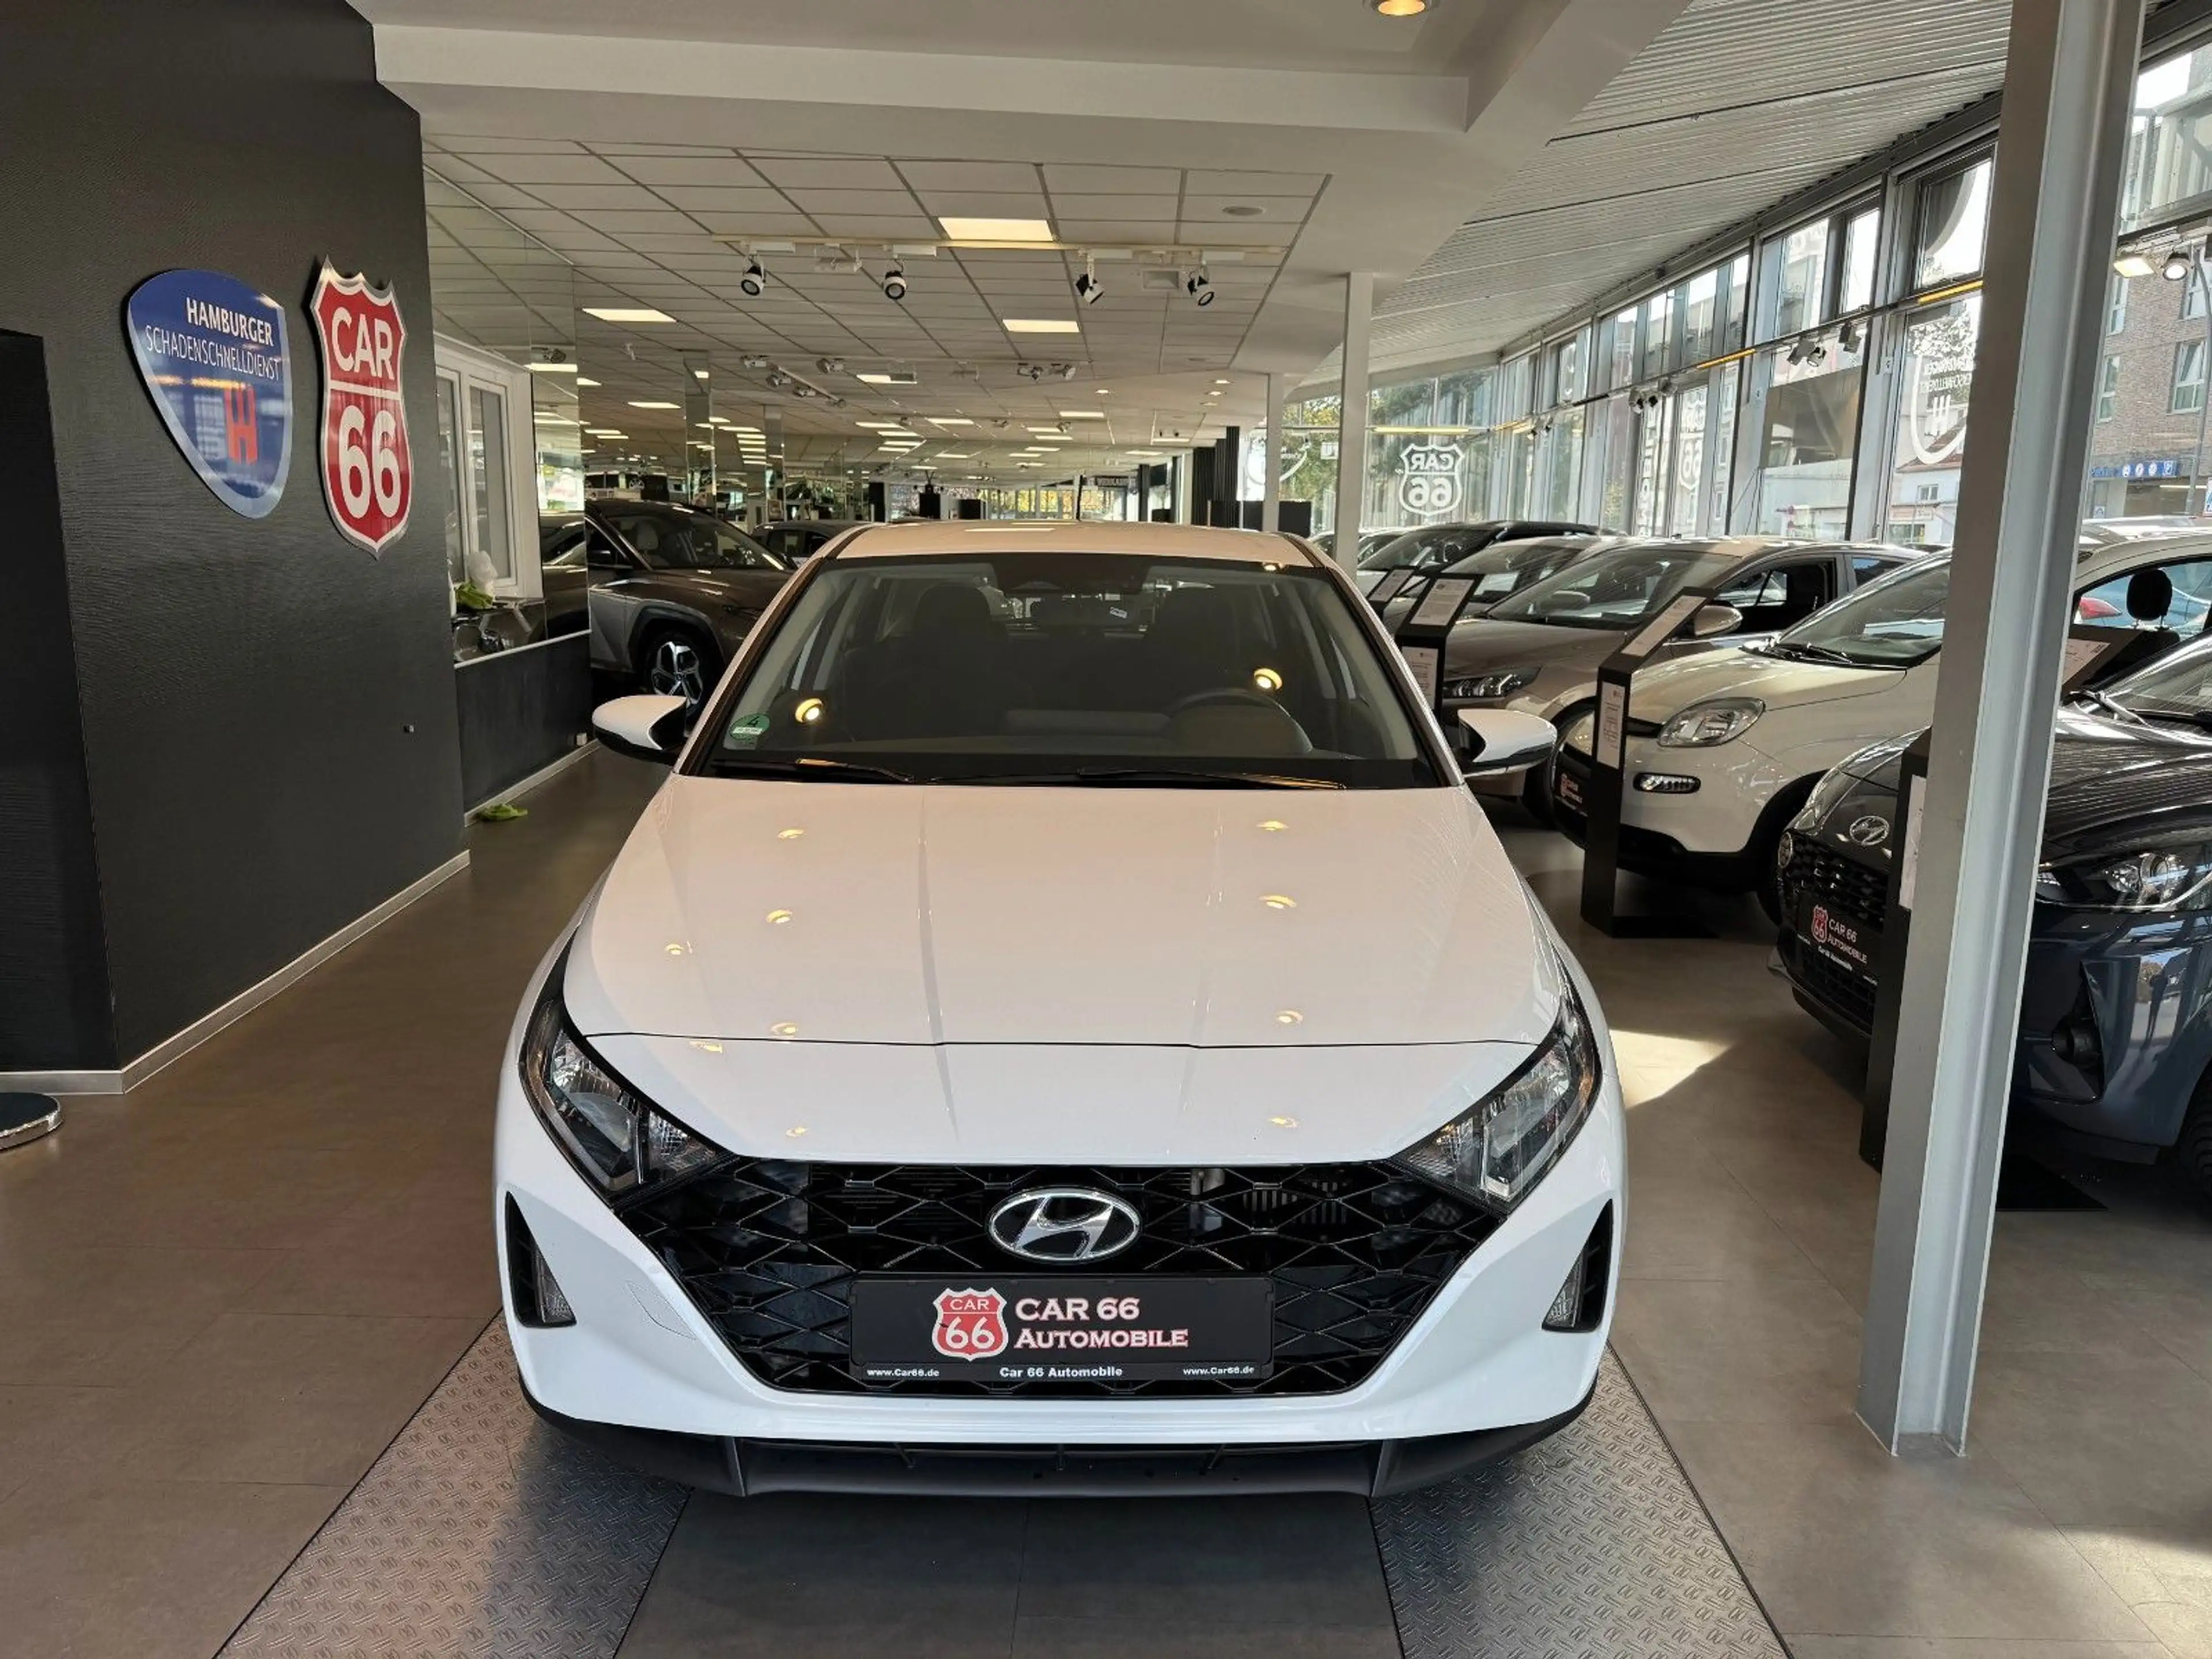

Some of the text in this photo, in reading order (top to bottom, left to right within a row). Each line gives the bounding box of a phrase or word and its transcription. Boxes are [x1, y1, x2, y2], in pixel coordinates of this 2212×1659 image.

[186, 297, 274, 347] HAMBURGER
[145, 324, 281, 381] SCHADENSCHNELLDIENST
[331, 306, 395, 380] CAR
[339, 404, 402, 519] 66
[747, 715, 760, 727] 4
[1828, 919, 1846, 937] CAR
[950, 1299, 990, 1310] CAR
[1015, 1297, 1140, 1321] CAR 66
[945, 1316, 995, 1349] 66
[1013, 1328, 1188, 1349] AUTOMOBILE
[866, 1368, 940, 1377] www.Car66.de
[999, 1366, 1123, 1377] Car 66 Automobile
[1183, 1366, 1255, 1376] www.Car66.de
